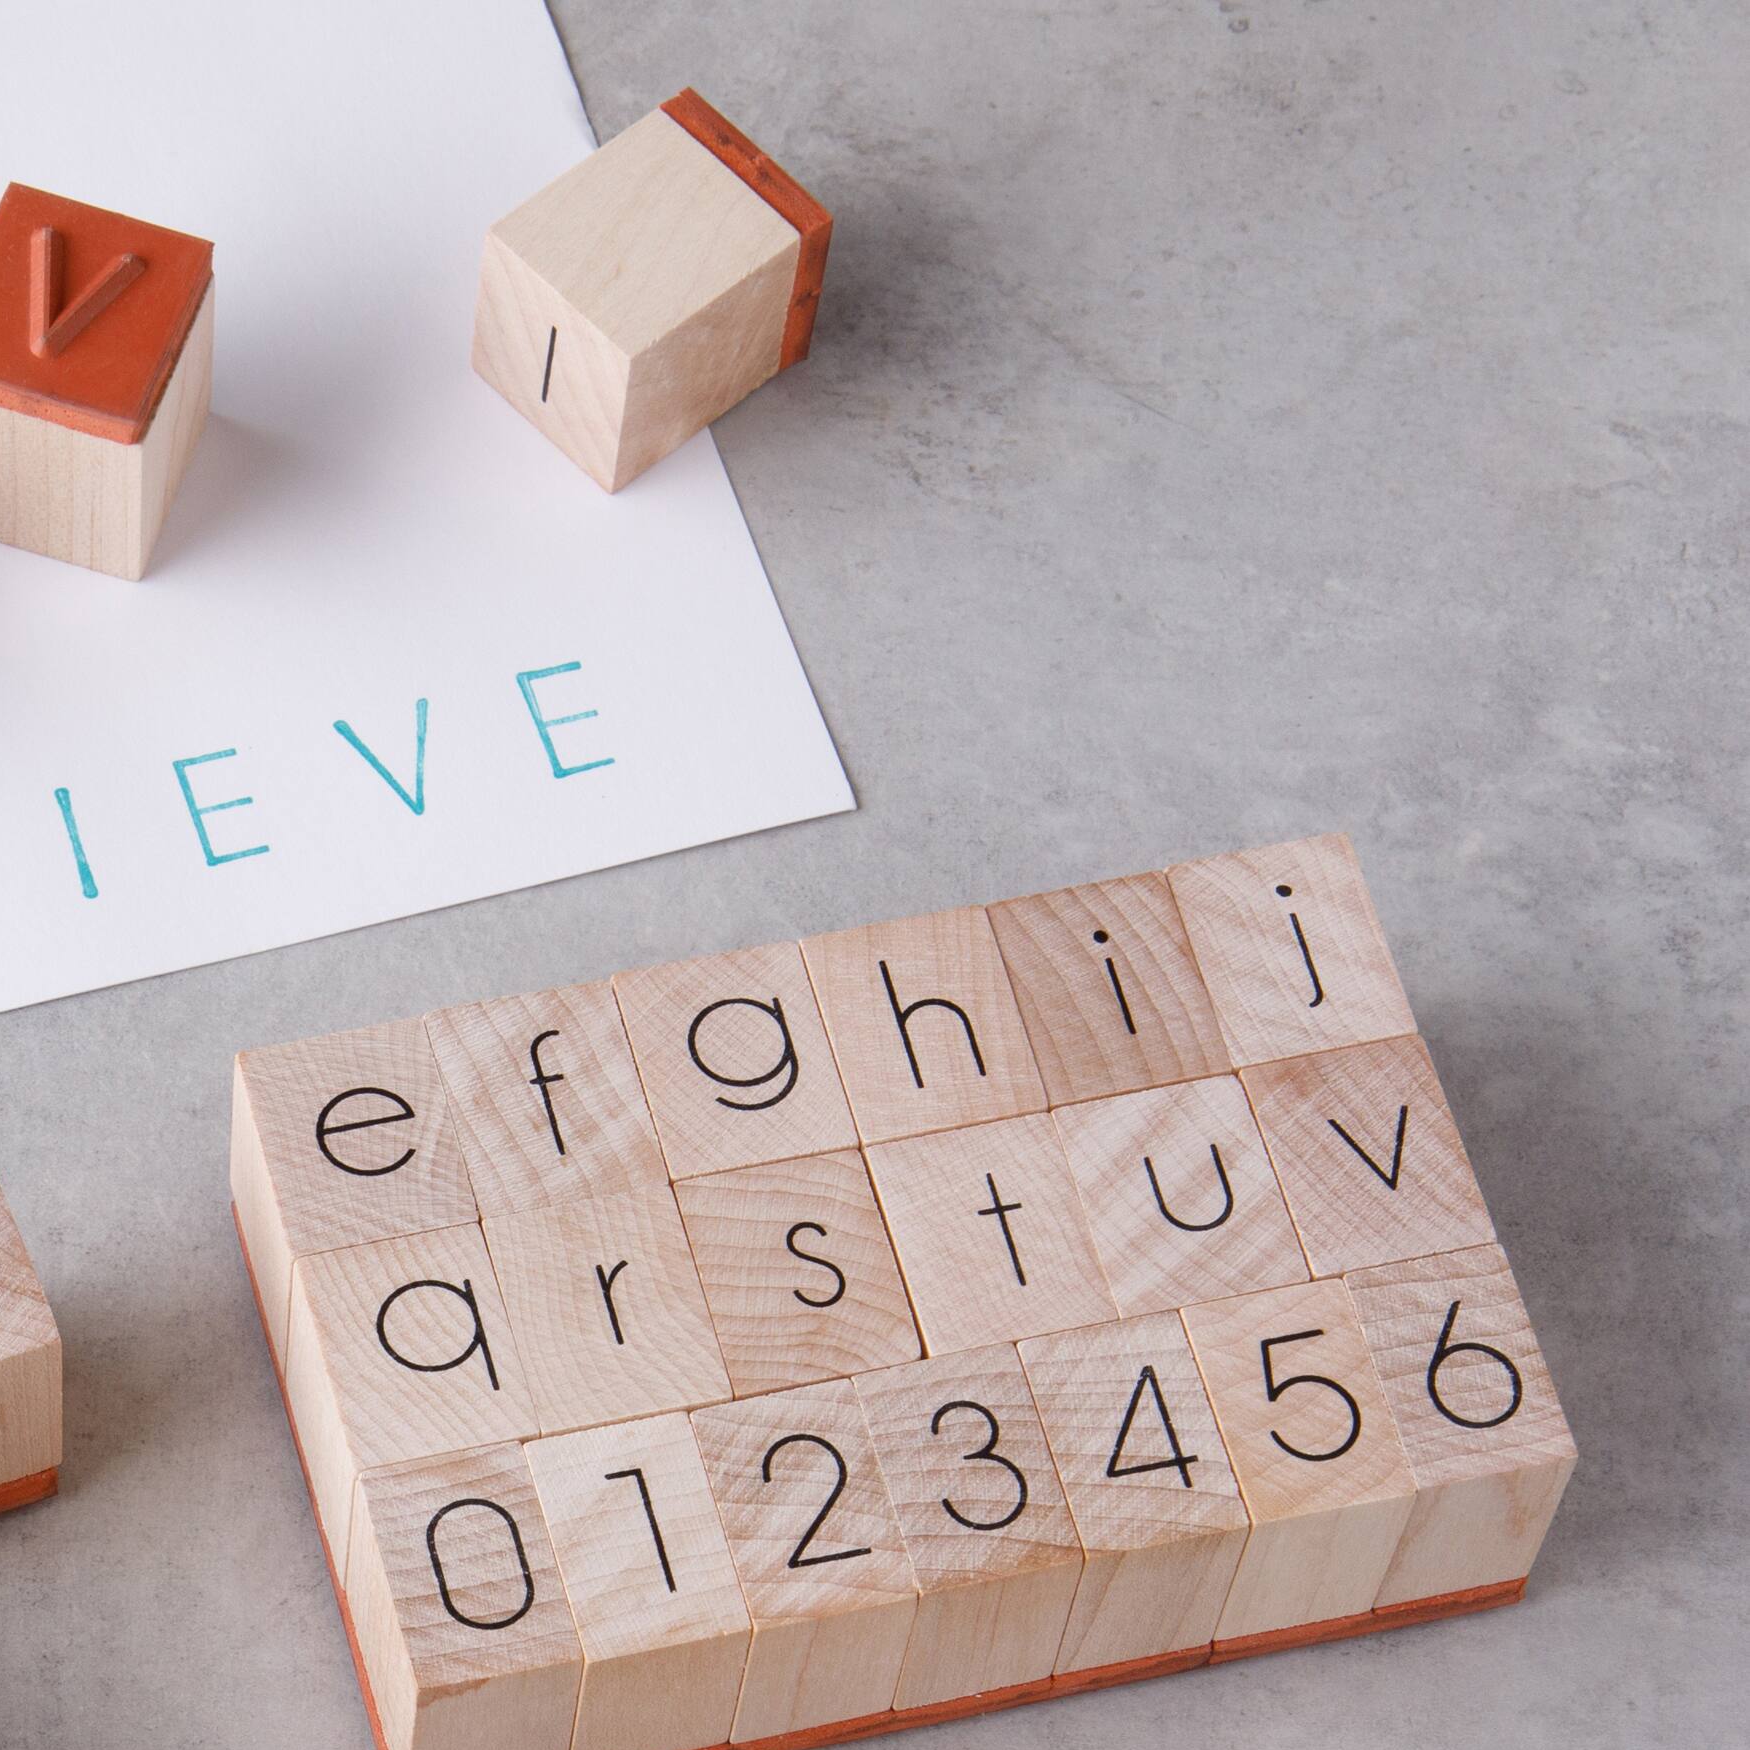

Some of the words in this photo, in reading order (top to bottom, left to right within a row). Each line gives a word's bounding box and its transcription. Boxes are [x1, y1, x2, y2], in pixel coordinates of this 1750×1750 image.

[29, 226, 147, 359] V
[315, 1087, 416, 1177] e
[529, 1030, 566, 1156] f
[687, 997, 799, 1111] g
[878, 960, 987, 1089] h
[1093, 929, 1137, 1035] i
[1275, 885, 1324, 1008] j
[376, 1278, 500, 1391] q
[595, 1260, 628, 1345] r
[786, 1221, 846, 1308] s
[977, 1173, 1027, 1286] t
[1144, 1143, 1234, 1232] u
[1327, 1105, 1408, 1191] v
[426, 1498, 535, 1631] 0
[604, 1468, 676, 1593] 1
[761, 1433, 872, 1569] 2
[930, 1400, 1028, 1531] 3
[1106, 1365, 1199, 1489] 4
[1260, 1329, 1361, 1462] 5
[1427, 1300, 1523, 1429] 6
